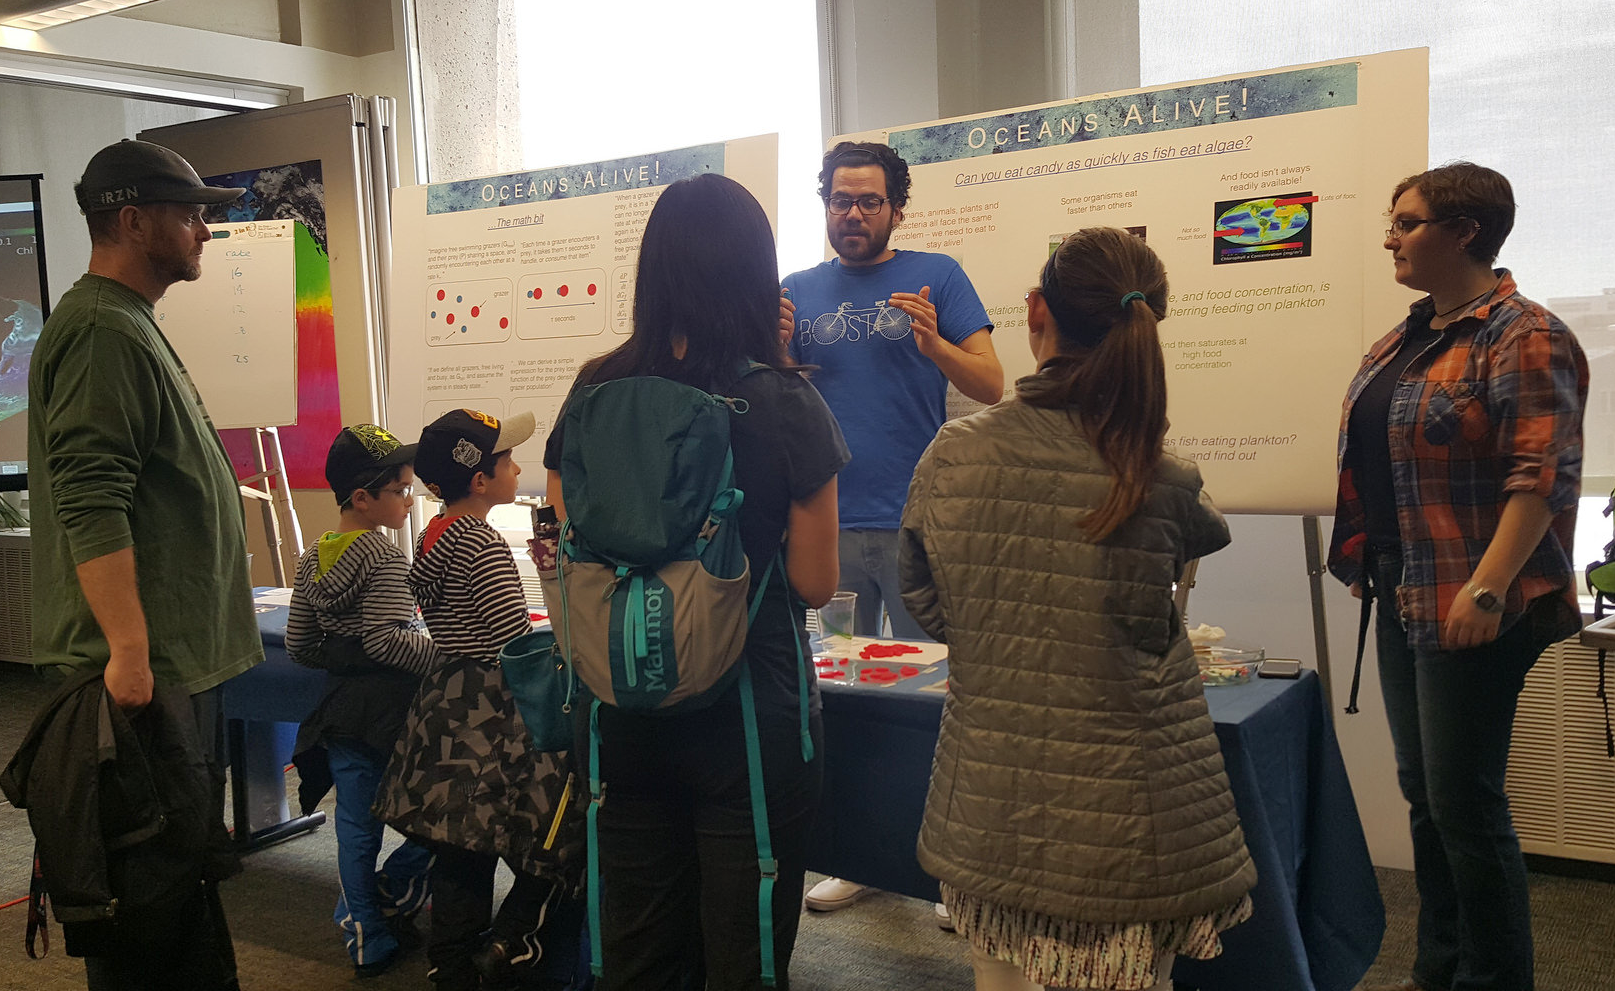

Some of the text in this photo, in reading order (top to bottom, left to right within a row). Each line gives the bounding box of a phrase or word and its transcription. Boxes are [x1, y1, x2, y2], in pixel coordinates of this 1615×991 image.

[968, 87, 1247, 149] OCEANS ALIVE!
[955, 135, 1253, 186] Can you eat candy as quickly as fish eat algae?
[482, 160, 661, 203] OCEANS ALIVE!
[1220, 165, 1311, 183] And food isn't always
[1230, 176, 1303, 193] readily available!
[1060, 190, 1138, 206] Some organisms eat
[927, 207, 958, 217] animals,
[960, 203, 982, 215] plants
[984, 201, 999, 211] and
[1067, 201, 1133, 215] faster than others
[513, 215, 532, 227] math
[534, 214, 545, 224] bit
[930, 219, 938, 228] all
[940, 217, 956, 227] face
[958, 215, 970, 224] the
[972, 214, 992, 223] same
[894, 224, 996, 243] problem we need to eat to
[16, 247, 33, 255] Chl
[926, 237, 964, 249] stay alive!
[1182, 291, 1203, 302] and
[1207, 288, 1232, 300] food
[1235, 284, 1316, 299] concentration,
[1320, 281, 1331, 292] is
[1170, 297, 1325, 318] herring feeding on plankton
[1004, 319, 1016, 328] as
[1178, 340, 1196, 349] then
[1198, 338, 1237, 348] saturates
[1239, 337, 1248, 346] at
[1183, 350, 1222, 361] high food
[1175, 360, 1232, 370] concentration
[1179, 436, 1198, 446] fish
[1201, 436, 1237, 449] eating
[1239, 433, 1298, 448] plankton?
[1214, 450, 1236, 461] find
[1238, 450, 1257, 461] out
[644, 587, 667, 693] Marmot
